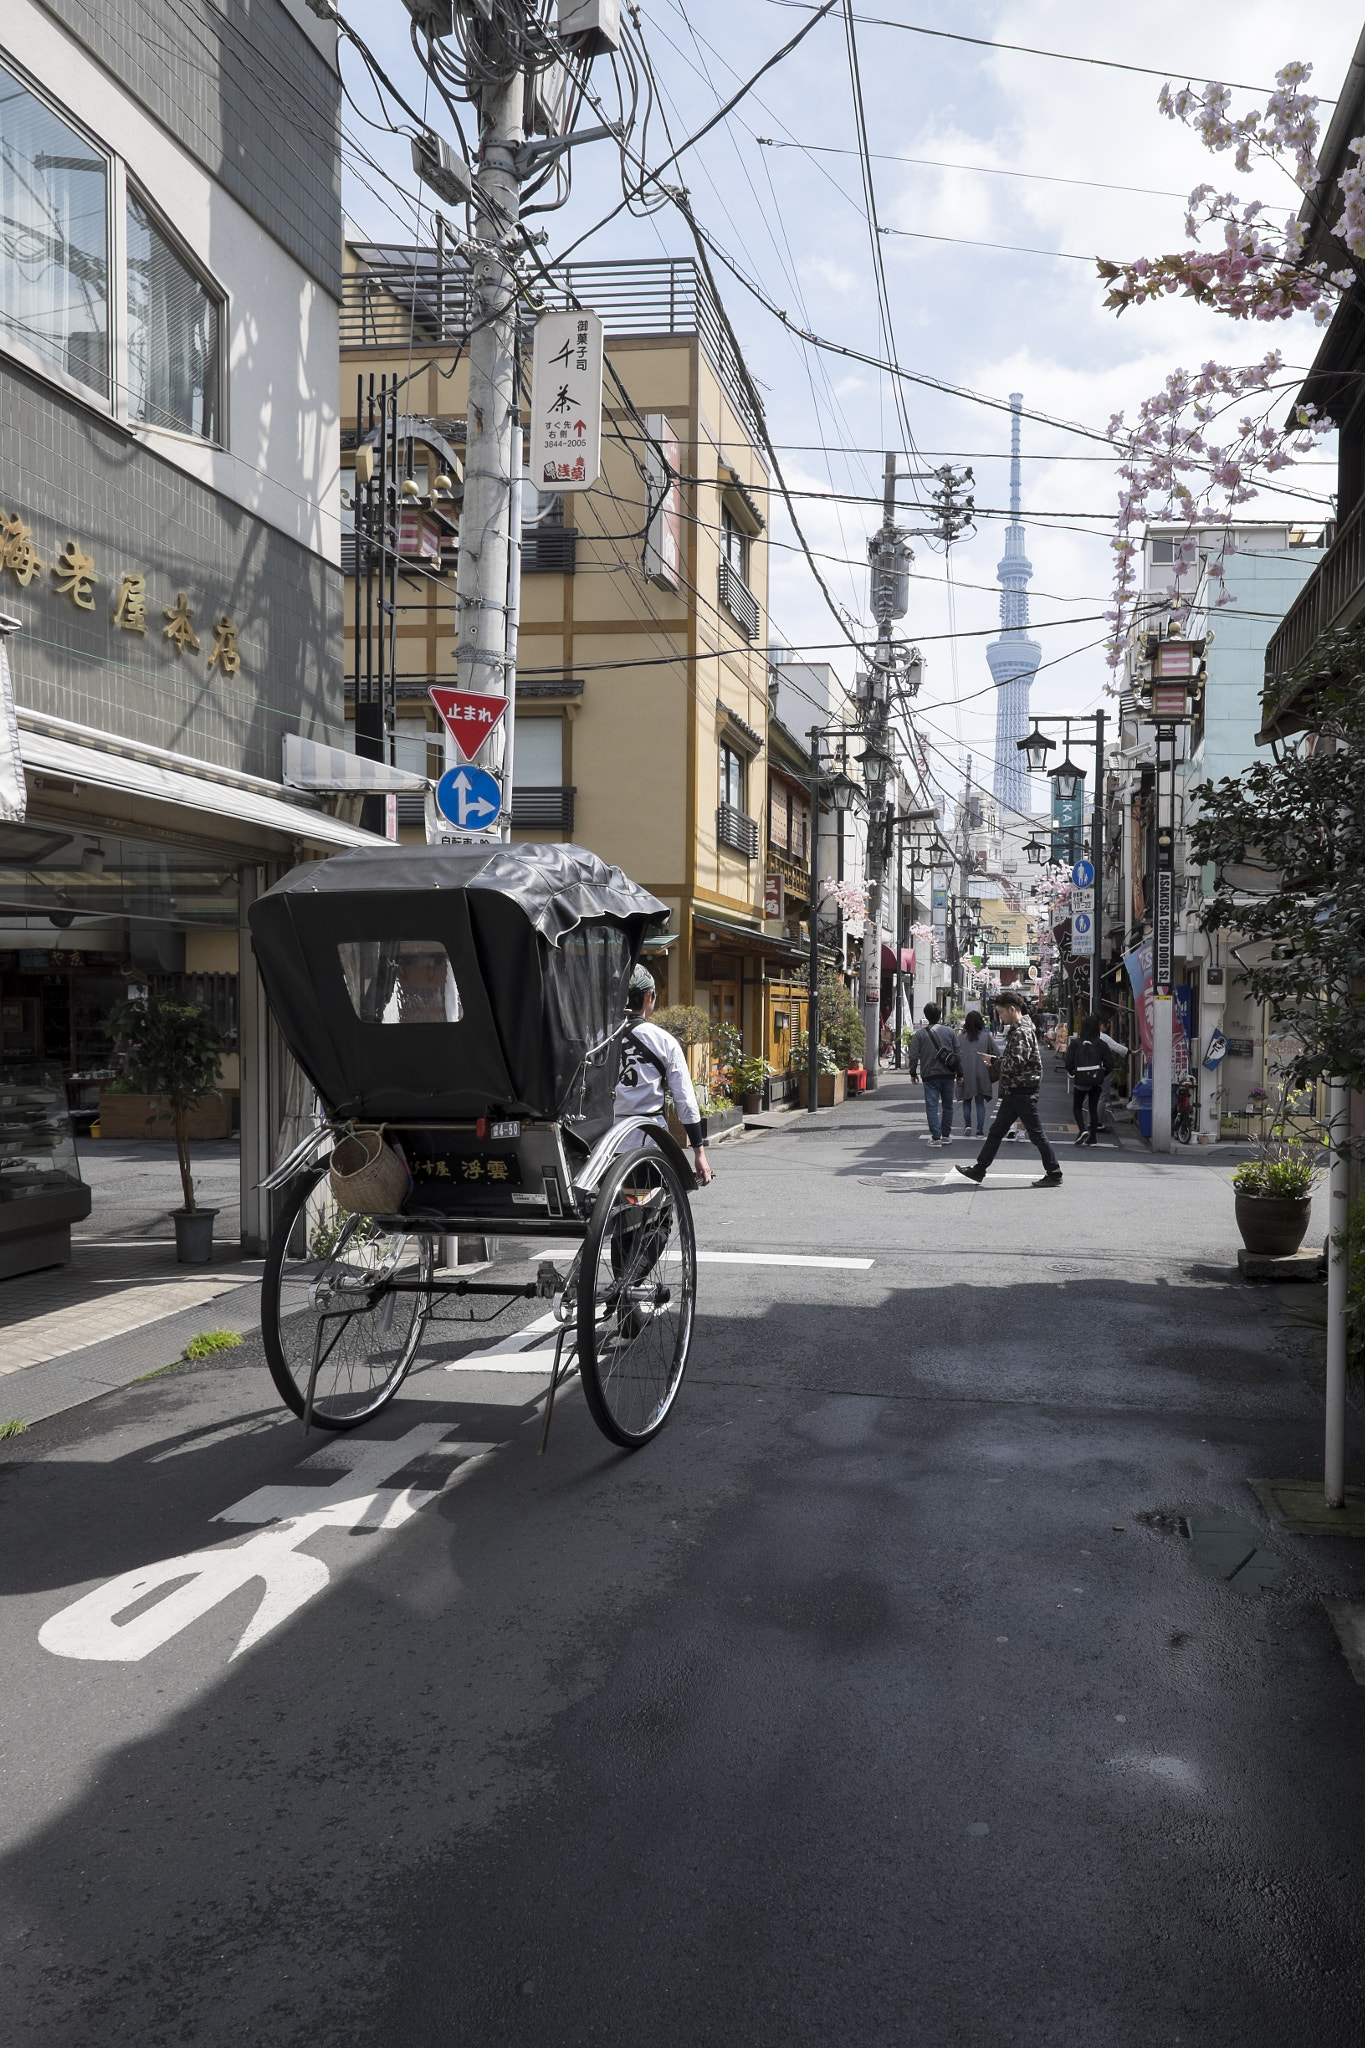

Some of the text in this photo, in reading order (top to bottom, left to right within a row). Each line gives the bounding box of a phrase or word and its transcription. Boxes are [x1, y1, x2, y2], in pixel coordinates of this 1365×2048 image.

[576, 319, 589, 371] 御菓子司
[544, 420, 572, 430] すぐ先
[548, 430, 568, 439] 右側
[544, 439, 587, 449] 3844-2005
[557, 463, 585, 480] 浅草
[446, 702, 494, 723] 止まれ
[1159, 873, 1170, 917] ASAKUSA
[1159, 919, 1170, 944] CHUO
[1159, 946, 1169, 969] DORI
